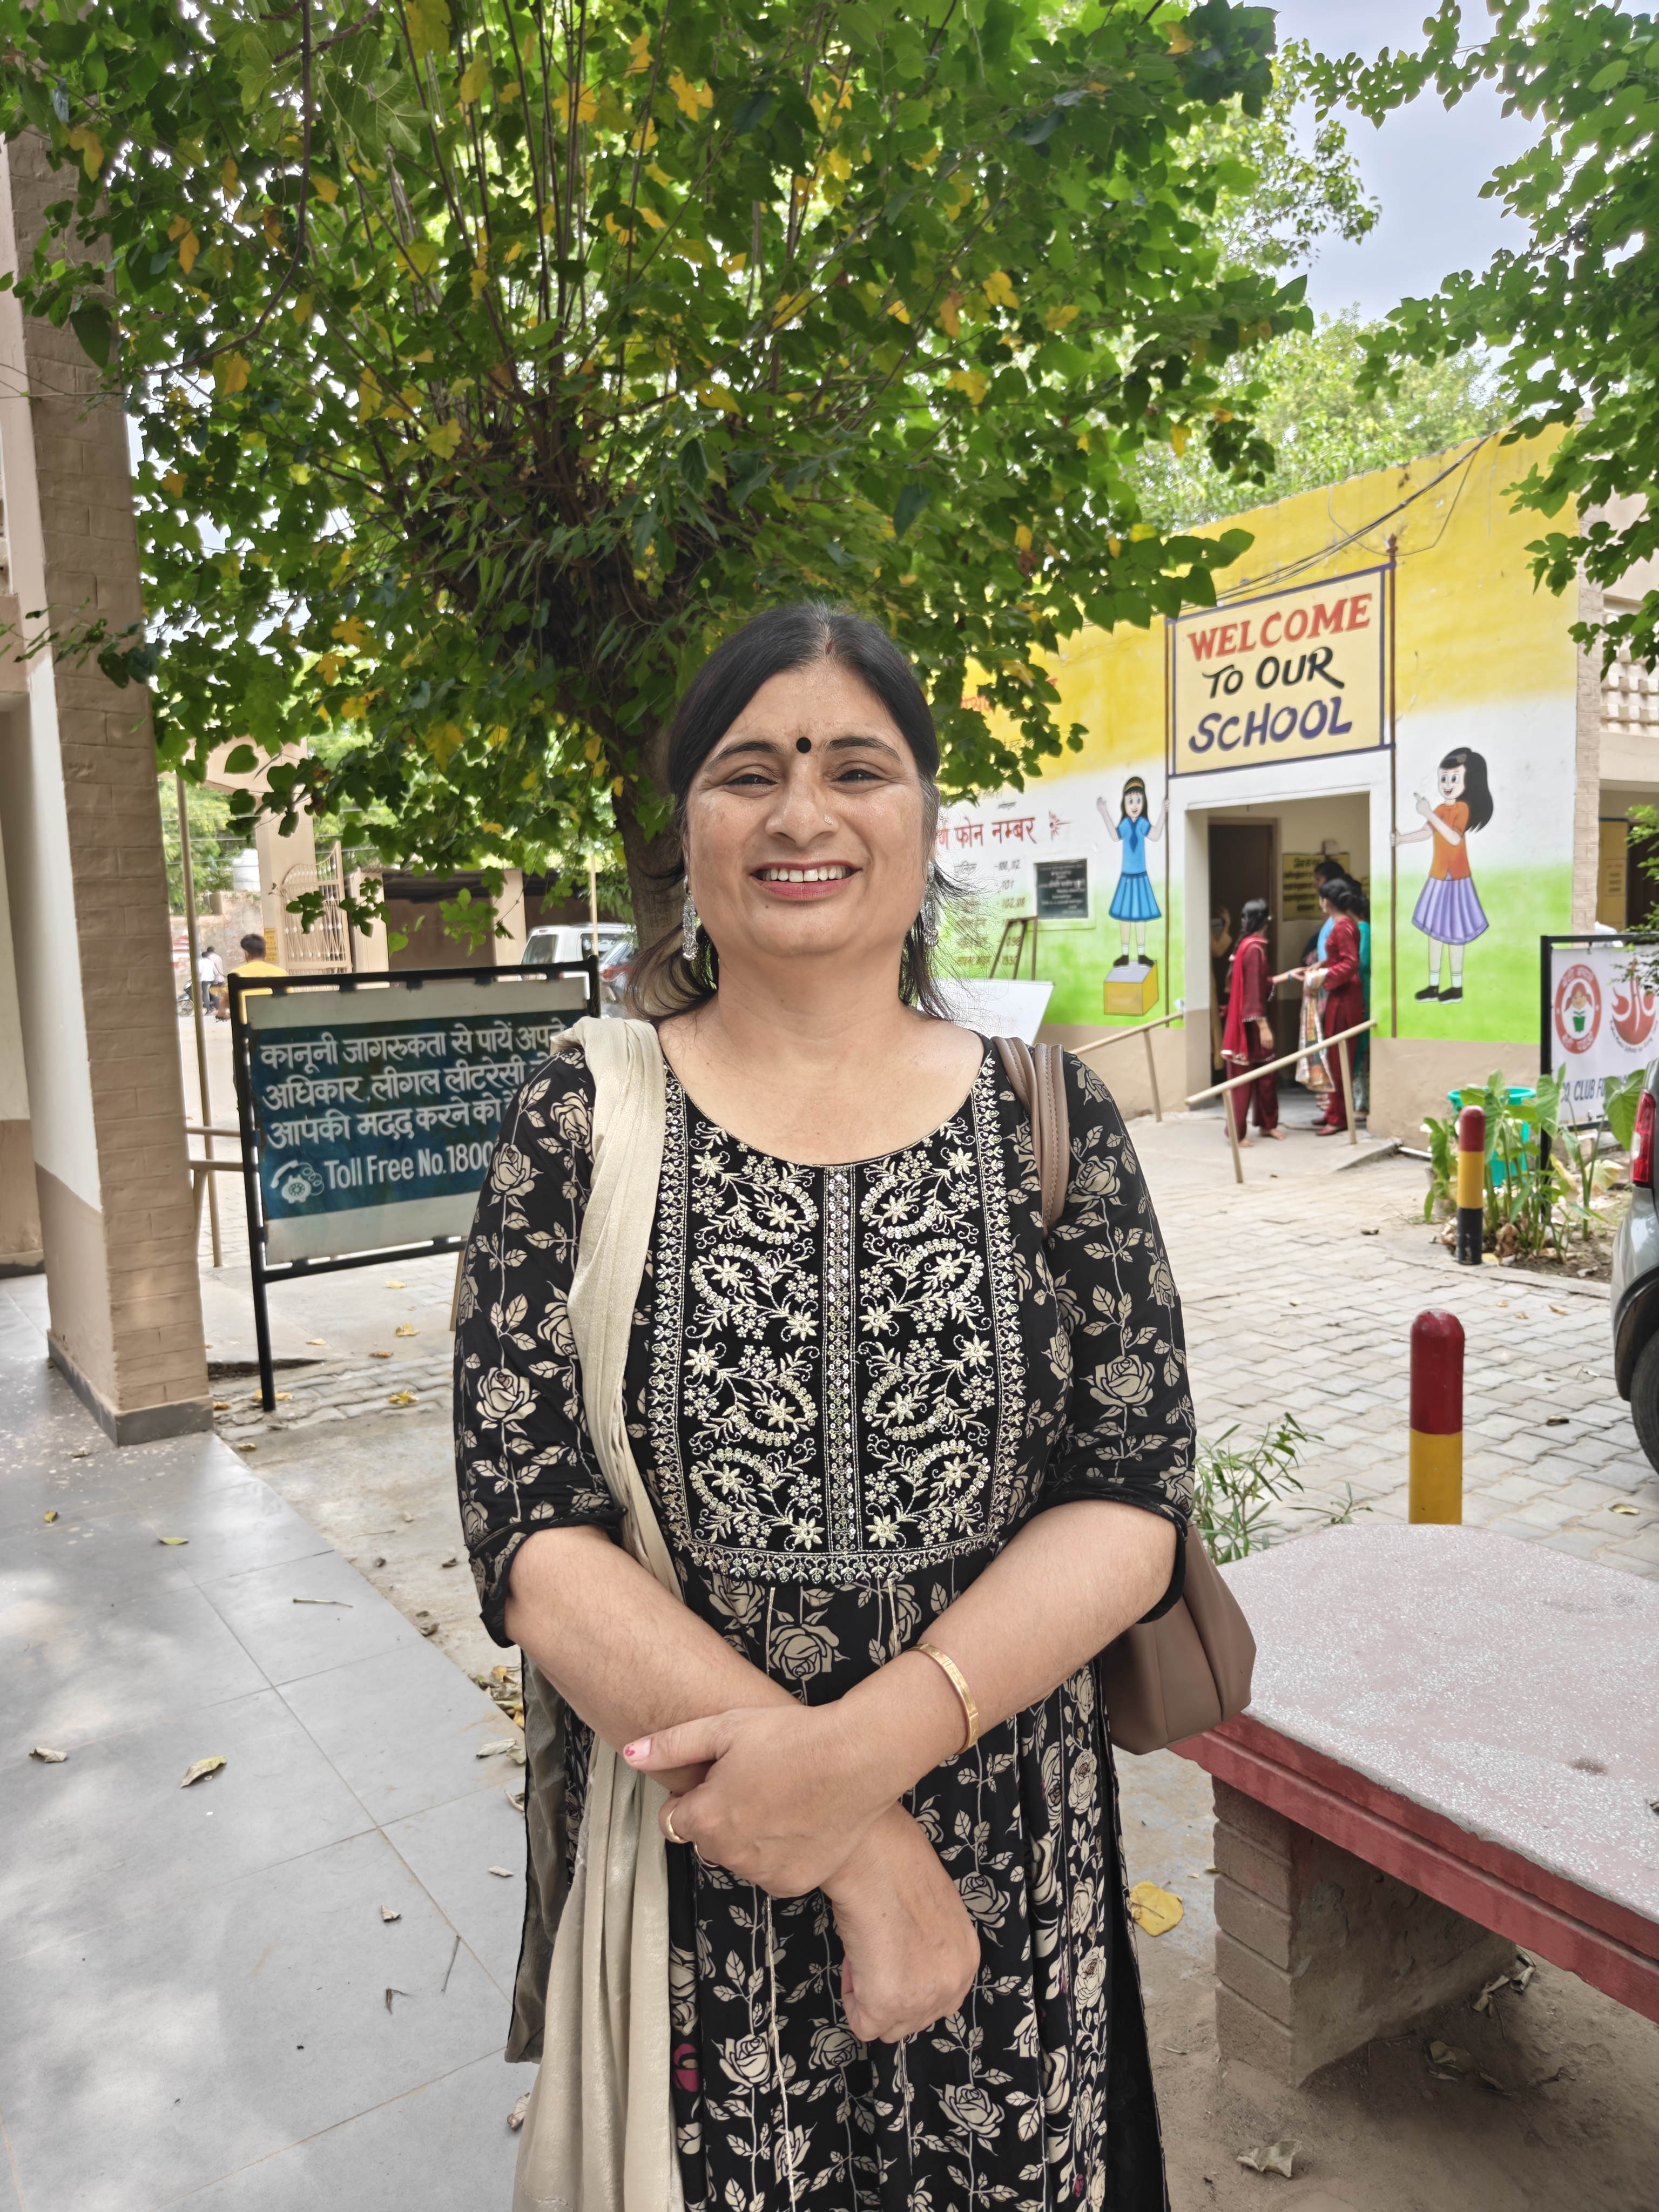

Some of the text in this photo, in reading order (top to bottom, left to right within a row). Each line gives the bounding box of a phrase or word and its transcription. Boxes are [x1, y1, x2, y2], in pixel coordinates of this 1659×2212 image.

[1187, 593, 1372, 662] WELCOME
[1256, 646, 1345, 690] OUR
[1188, 696, 1352, 754] SCHOOL
[954, 815, 983, 848] फोन
[992, 817, 1037, 845] नम्बर
[260, 1031, 338, 1074] कानूनी
[450, 1022, 474, 1054] से
[475, 1020, 514, 1053] पायें
[370, 1065, 441, 1100] लीगल
[443, 1054, 527, 1093] लीटरेसी
[1574, 1079, 1596, 1101] CLUB
[1597, 1077, 1606, 1098] FO
[267, 1109, 352, 1149] आपकी
[356, 1108, 415, 1141] मदद
[416, 1096, 470, 1131] करने
[472, 1092, 502, 1125] को
[324, 1159, 362, 1189] Toll
[367, 1155, 415, 1185] Free
